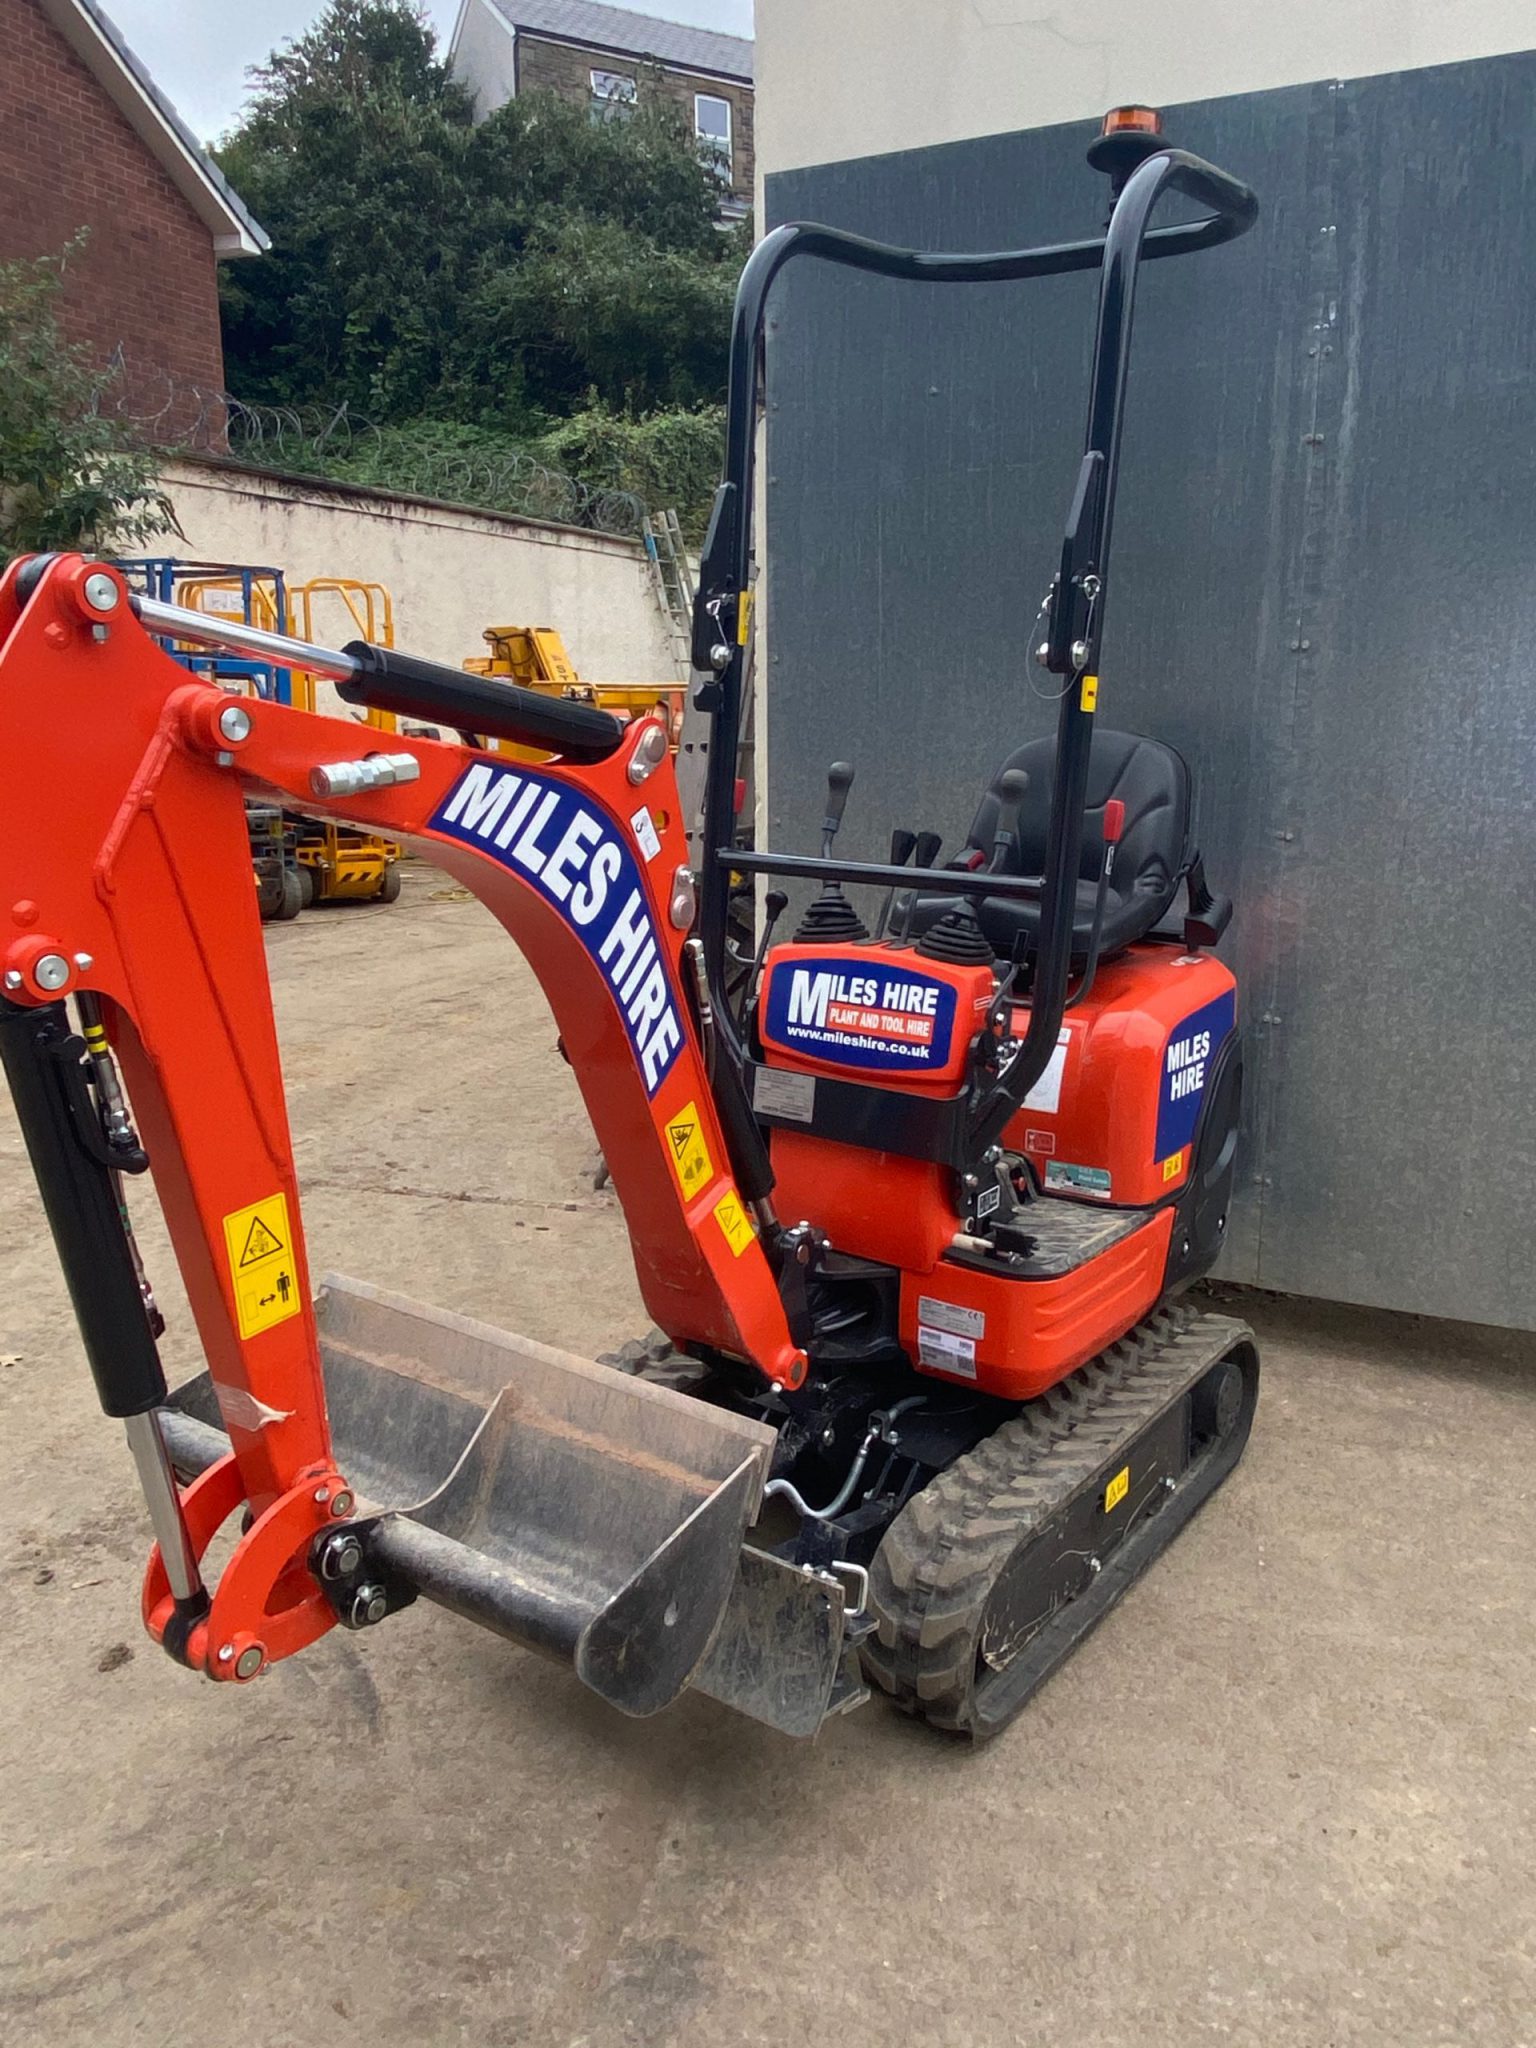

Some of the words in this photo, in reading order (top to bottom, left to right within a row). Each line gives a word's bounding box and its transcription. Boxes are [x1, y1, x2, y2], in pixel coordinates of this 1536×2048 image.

[442, 764, 622, 925] MILES
[598, 887, 680, 1092] HIRE
[788, 969, 878, 1028] MILES
[882, 981, 939, 1016] HIRE
[787, 1026, 930, 1059] www.mileshire.co.uk
[829, 1007, 860, 1027] PLANT
[860, 1012, 880, 1029] AND
[881, 1015, 905, 1034] TOOL
[906, 1018, 931, 1038] HIRE
[1167, 1031, 1210, 1073] MILES
[1170, 1062, 1204, 1101] HIRE
